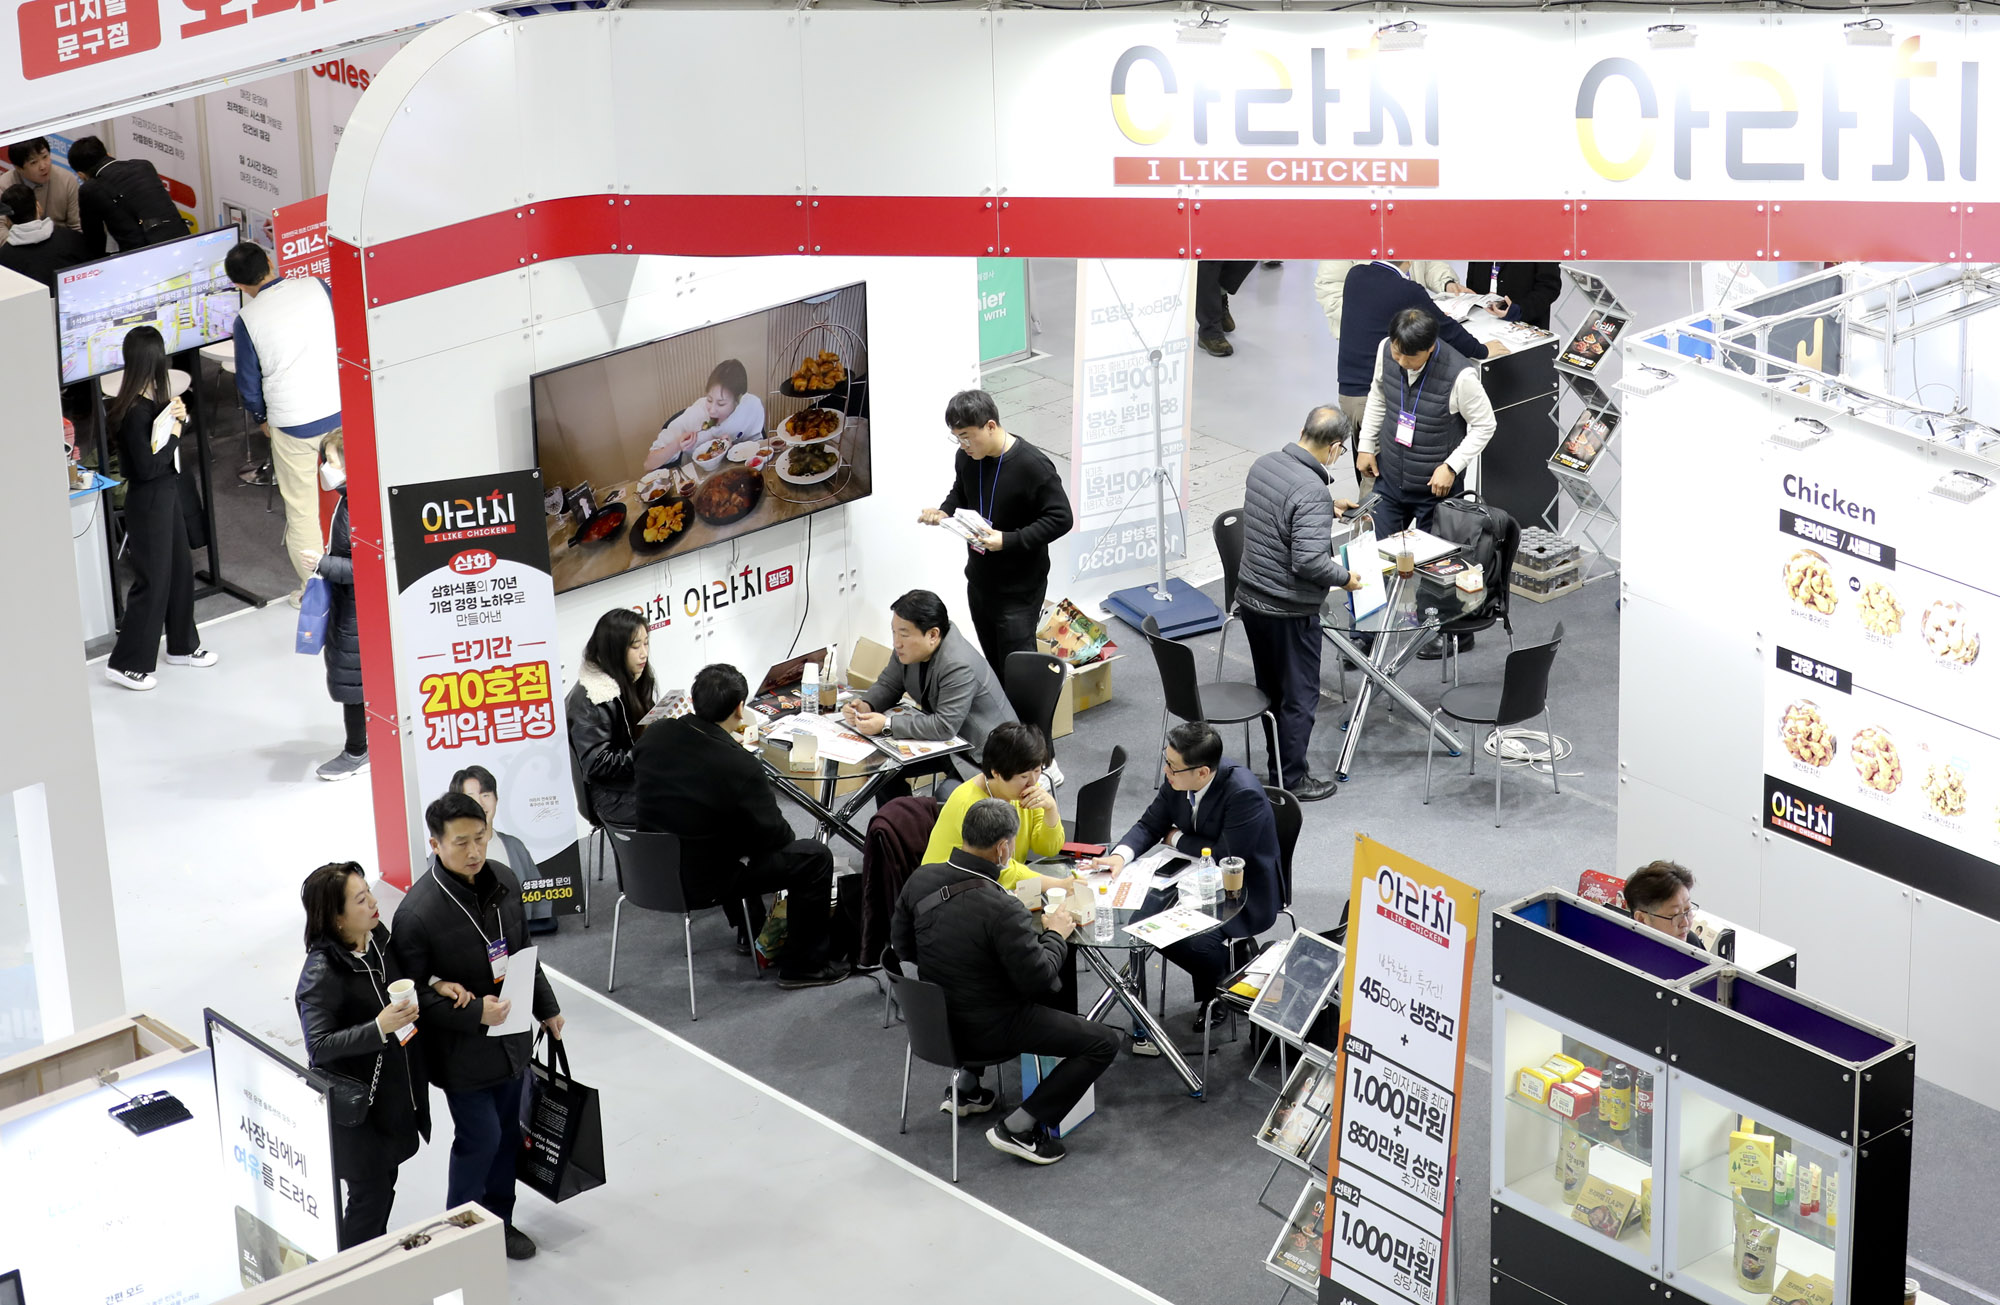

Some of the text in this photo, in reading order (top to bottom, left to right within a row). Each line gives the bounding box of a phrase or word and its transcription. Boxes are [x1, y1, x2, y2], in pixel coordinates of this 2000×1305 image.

[57, 21, 129, 62] 문구점
[1110, 34, 1440, 147] 아라치
[1575, 36, 1980, 182] 아라치
[1147, 160, 1410, 183] I LIKE CHICKEN
[984, 307, 1007, 321] WITH
[421, 489, 515, 532] 아라치
[1783, 474, 1876, 525] Chicken
[433, 527, 507, 542] I LIKE CHICKEN
[1794, 517, 1839, 547] 후라이드
[454, 552, 492, 571] 삼화
[429, 591, 526, 614] 기업 경영 노하우로
[431, 576, 518, 598] 삼화식품의 70년
[684, 565, 790, 617] 아라치 찜닭
[456, 610, 502, 627] 만들어낸
[452, 636, 513, 664] 단기간
[421, 663, 550, 714] 210호점
[1815, 664, 1838, 686] 치킨
[428, 702, 554, 747] 계약 달성
[1772, 791, 1833, 838] 아라치
[522, 876, 571, 891] 성공창업 문의
[1378, 869, 1453, 936] 아라치
[1390, 912, 1407, 927] LIKE
[1410, 922, 1443, 944] CHICKEN
[1359, 976, 1455, 1042] 45Box 냉장고
[1345, 1039, 1371, 1061] 선택1
[1382, 1066, 1449, 1109] 무이자 대출 최대
[1352, 1067, 1447, 1144] 1,000만원
[240, 1115, 308, 1178] 사장님에게
[1347, 1119, 1409, 1171] 850만원
[1412, 1153, 1443, 1188] 상당
[234, 1144, 320, 1220] 여유를 드려요
[1333, 1179, 1360, 1203] 선택2
[1401, 1172, 1442, 1205] 추가 지원!
[242, 1248, 258, 1268] 포스
[1341, 1210, 1435, 1288] 1,000만원
[1418, 1236, 1437, 1259] 최대
[125, 1284, 145, 1298] 모드
[1393, 1271, 1434, 1301] 상당 지원!
